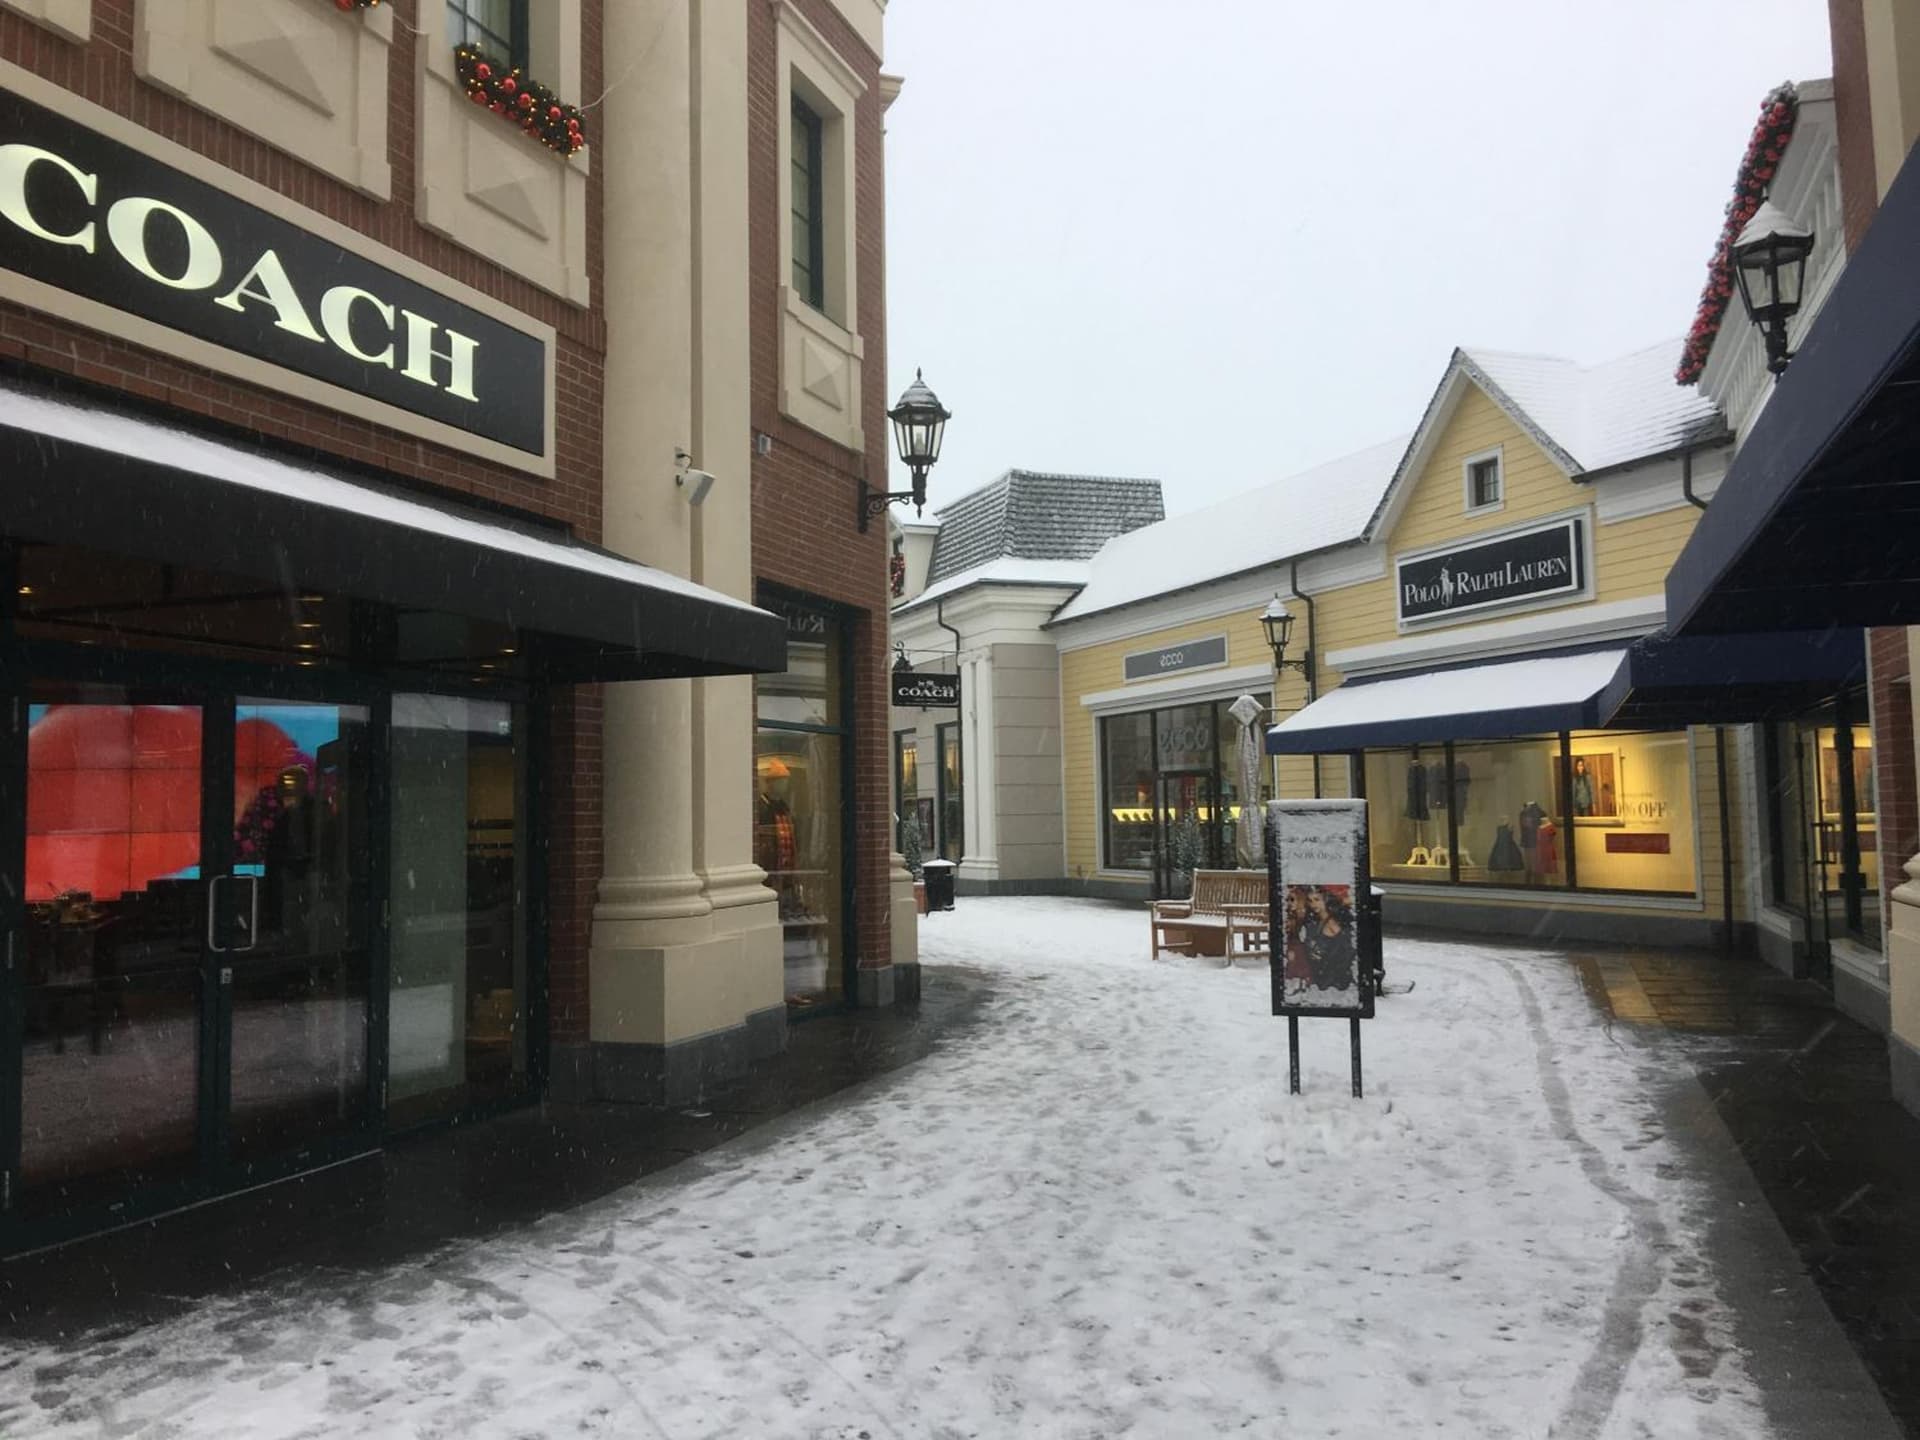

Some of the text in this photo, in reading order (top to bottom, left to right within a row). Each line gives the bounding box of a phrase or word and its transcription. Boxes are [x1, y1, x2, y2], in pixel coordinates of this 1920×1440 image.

[0, 144, 480, 402] COACH
[1404, 556, 1568, 606] POLO RALPH LAUREN
[1160, 651, 1184, 667] ecco
[898, 686, 954, 698] COACH
